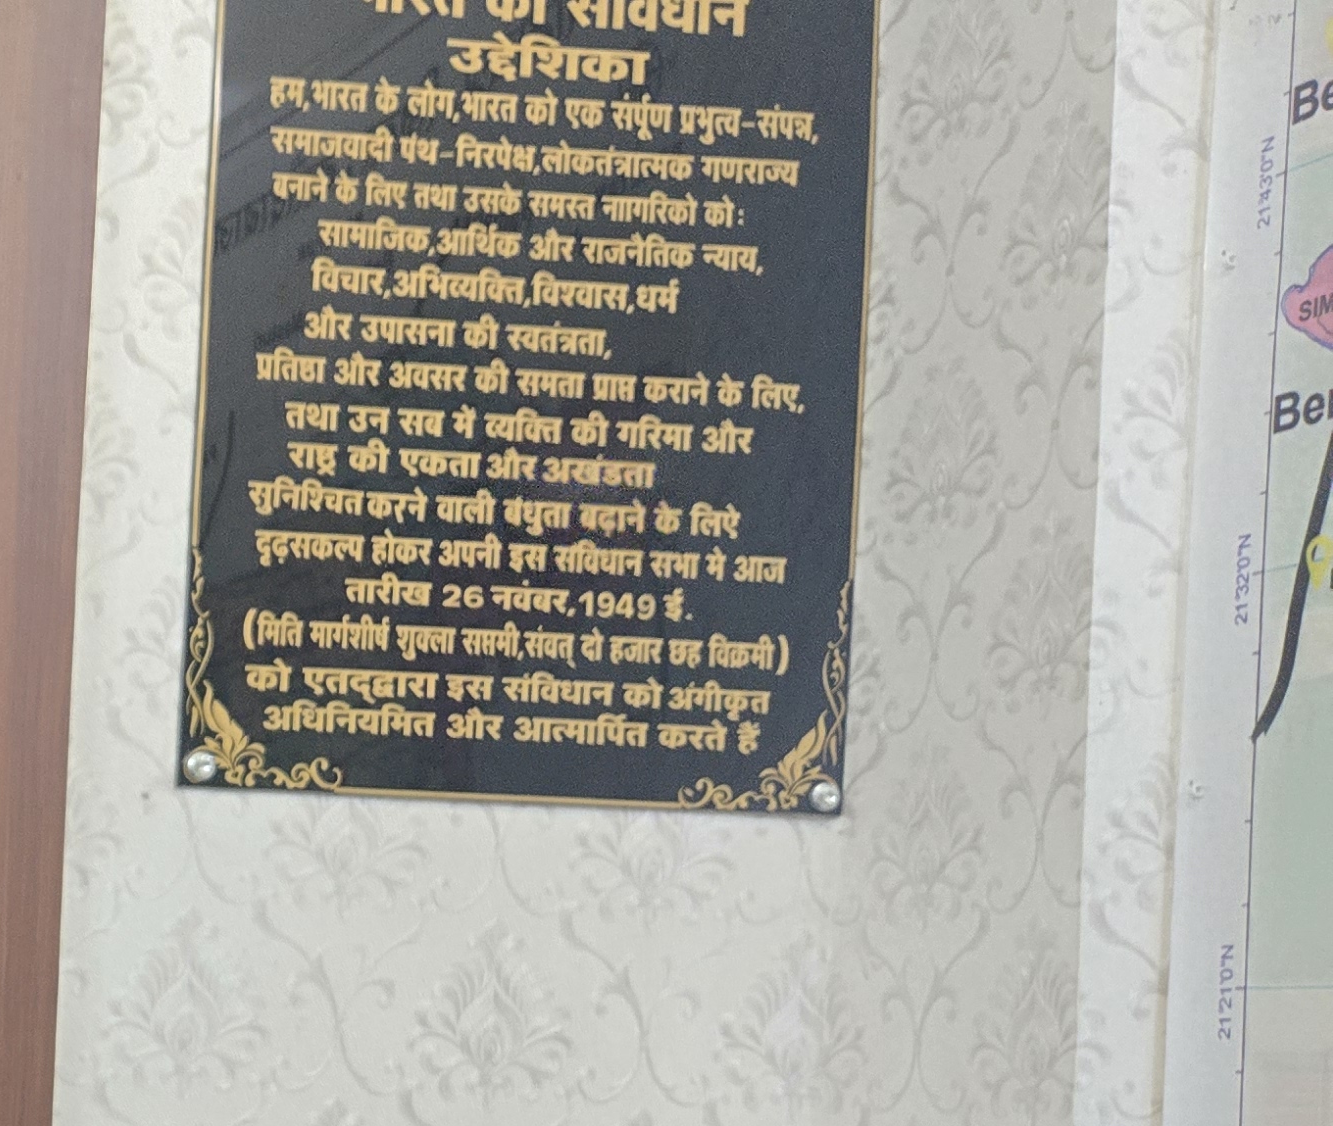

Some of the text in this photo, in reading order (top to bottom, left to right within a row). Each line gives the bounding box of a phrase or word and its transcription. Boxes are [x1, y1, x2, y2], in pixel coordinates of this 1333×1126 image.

[374, 77, 402, 115] के
[524, 89, 559, 126] को
[564, 98, 606, 129] एक
[271, 125, 395, 162] समाजवादी
[701, 156, 800, 186] गणराज्य
[334, 170, 360, 205] के
[364, 171, 410, 209] लिए
[413, 183, 459, 211] तथा
[463, 182, 523, 216] उसके
[528, 190, 596, 220] समस्त
[529, 228, 576, 261] और
[582, 233, 695, 269] राजनैतिक
[702, 244, 762, 274] न्याय,
[303, 305, 611, 359] और उपासना की स्वतंत्रता,
[333, 351, 382, 386] और
[388, 361, 469, 392] अवसर
[474, 357, 510, 394] की
[515, 368, 586, 398] समता
[643, 373, 710, 405] कराने
[717, 374, 744, 407] के
[752, 374, 803, 412] लिए,
[285, 401, 341, 432] तथा
[348, 405, 390, 435] उन
[398, 408, 446, 437] सब
[484, 407, 563, 444] व्यक्ति
[570, 410, 610, 447] की
[616, 414, 693, 451] गरिमा
[702, 419, 754, 453] और
[348, 437, 391, 474] की
[399, 448, 483, 479] एकता
[486, 447, 538, 480] और
[248, 475, 366, 516] सुनिश्चित
[365, 487, 428, 522] करने
[435, 488, 496, 525] वाली
[655, 501, 682, 535] के
[371, 530, 433, 565] होकर
[438, 532, 503, 569] अपनी
[508, 543, 549, 573] इस
[650, 550, 700, 578] सभा
[734, 556, 787, 582] आज
[344, 571, 433, 607] तारीख
[442, 583, 485, 610] 26
[395, 625, 457, 662] शुक्ला
[581, 629, 604, 661] दो
[610, 636, 664, 664] हजार
[668, 639, 703, 668] छह
[245, 658, 293, 693] को
[446, 674, 494, 702] इस
[502, 671, 614, 706] संविधान
[623, 678, 663, 709] को
[669, 680, 770, 721] अंगीकृत
[262, 701, 436, 738] अधिनियमित
[446, 707, 504, 740] और
[514, 713, 649, 747] आत्मार्पित
[658, 720, 728, 751] करते
